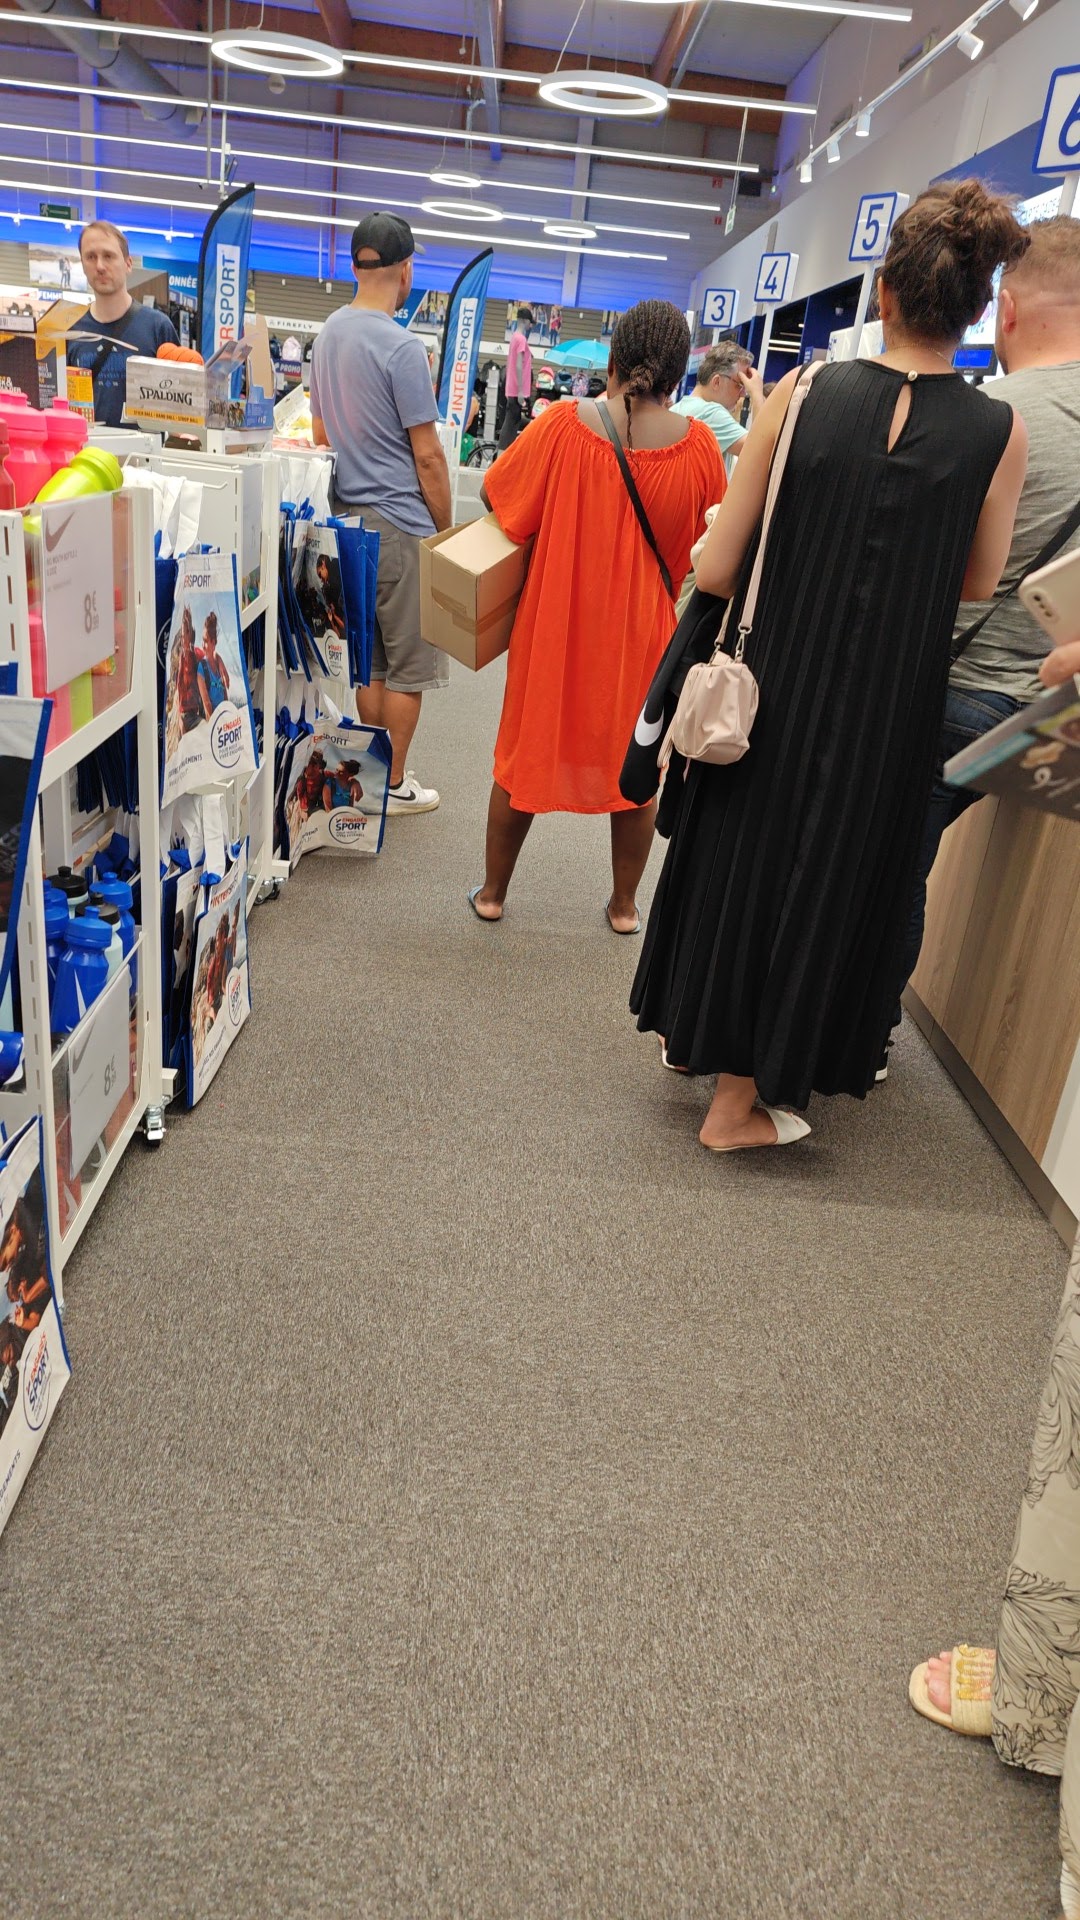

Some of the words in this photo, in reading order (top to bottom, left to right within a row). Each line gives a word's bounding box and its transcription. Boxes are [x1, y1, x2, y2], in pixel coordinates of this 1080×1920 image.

[862, 203, 885, 251] 5
[763, 260, 780, 295] 4
[219, 253, 236, 347] RSPORT
[710, 294, 726, 322] 3
[277, 320, 313, 330] FIREFLY
[280, 363, 301, 373] PROMO
[451, 306, 475, 412] INTERSPORT
[139, 386, 193, 407] SPALDING
[217, 725, 242, 749] SPORT
[335, 822, 367, 832] SPORT
[29, 1340, 50, 1412] SPORT
